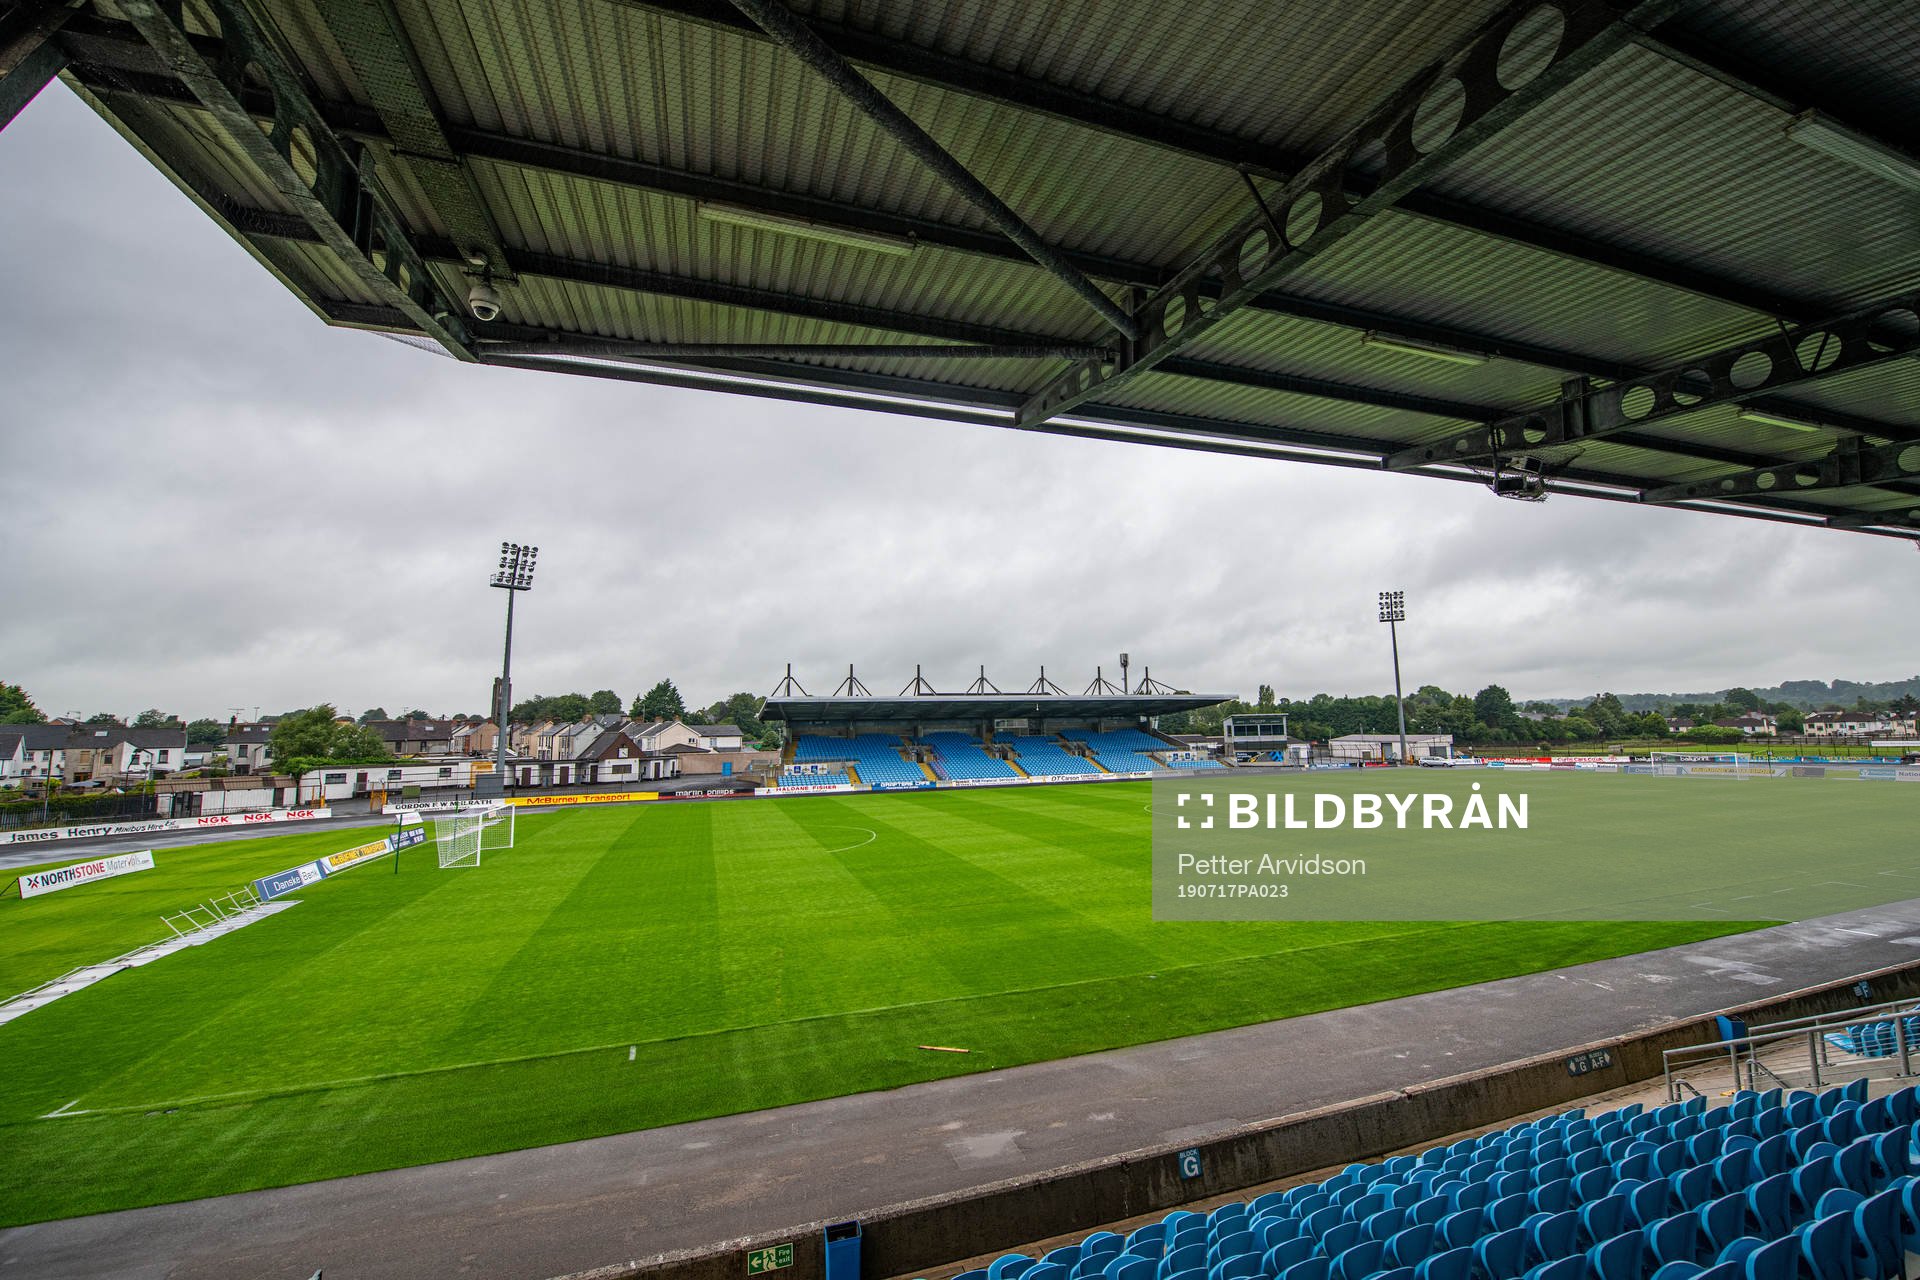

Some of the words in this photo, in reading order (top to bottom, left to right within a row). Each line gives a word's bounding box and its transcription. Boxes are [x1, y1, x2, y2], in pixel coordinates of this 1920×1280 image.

[527, 797, 578, 805] McBurney
[583, 794, 631, 802] Transport
[198, 816, 229, 825] NGK
[244, 813, 272, 821] NGK
[287, 810, 315, 818] NGK
[11, 831, 59, 843] James
[67, 827, 112, 837] Henry
[41, 862, 106, 887] NORTHSTONE
[273, 875, 301, 892] Danske
[301, 870, 318, 881] Bank
[1179, 1149, 1197, 1158] BLOCK
[1183, 1156, 1199, 1177] G
